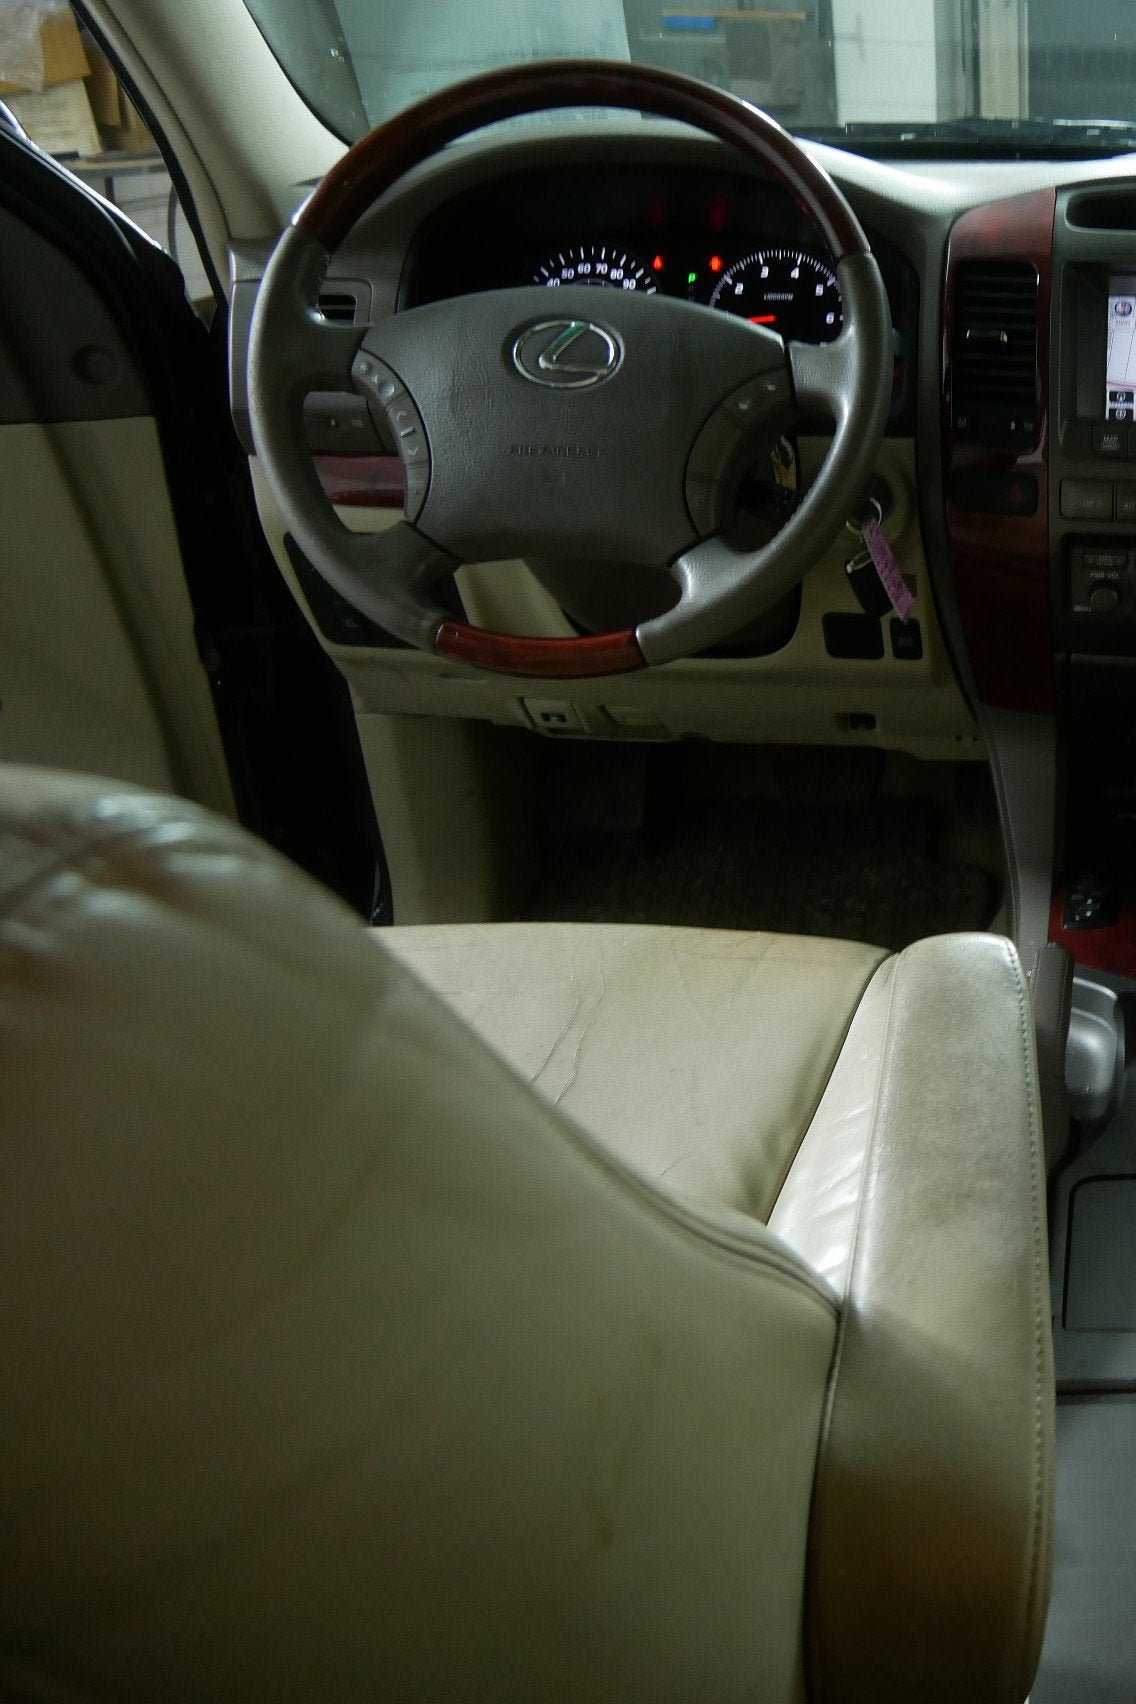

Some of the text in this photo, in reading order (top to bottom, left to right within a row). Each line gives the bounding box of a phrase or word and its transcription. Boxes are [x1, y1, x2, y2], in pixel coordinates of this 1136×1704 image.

[577, 262, 591, 274] 60
[595, 262, 608, 275] 70
[610, 268, 624, 280] 80
[622, 278, 637, 290] 90
